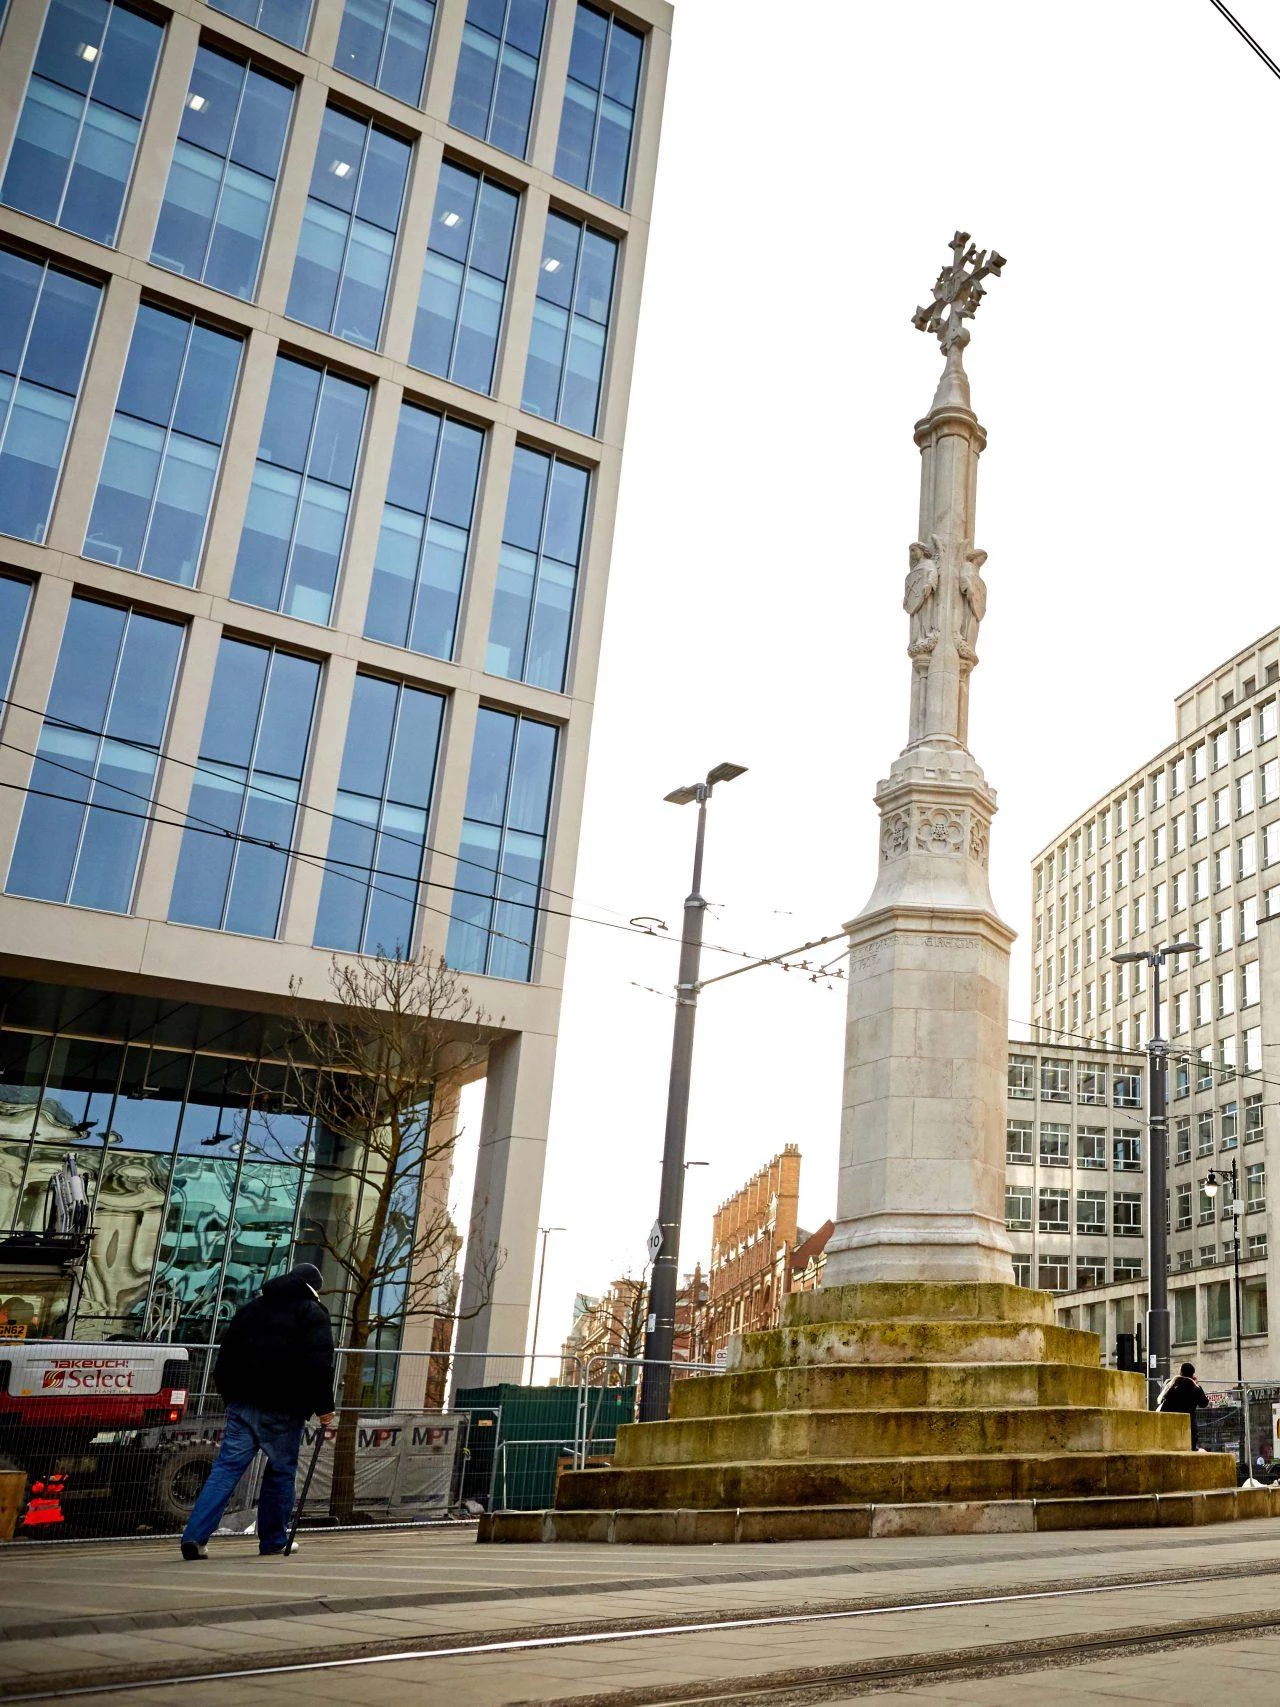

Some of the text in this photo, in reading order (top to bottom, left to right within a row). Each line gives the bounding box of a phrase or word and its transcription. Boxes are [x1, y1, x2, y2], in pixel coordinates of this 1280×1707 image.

[650, 1235, 660, 1248] 10
[67, 1369, 135, 1388] Select
[300, 1427, 337, 1446] MP
[358, 1428, 402, 1448] MPT
[411, 1427, 454, 1446] MPT
